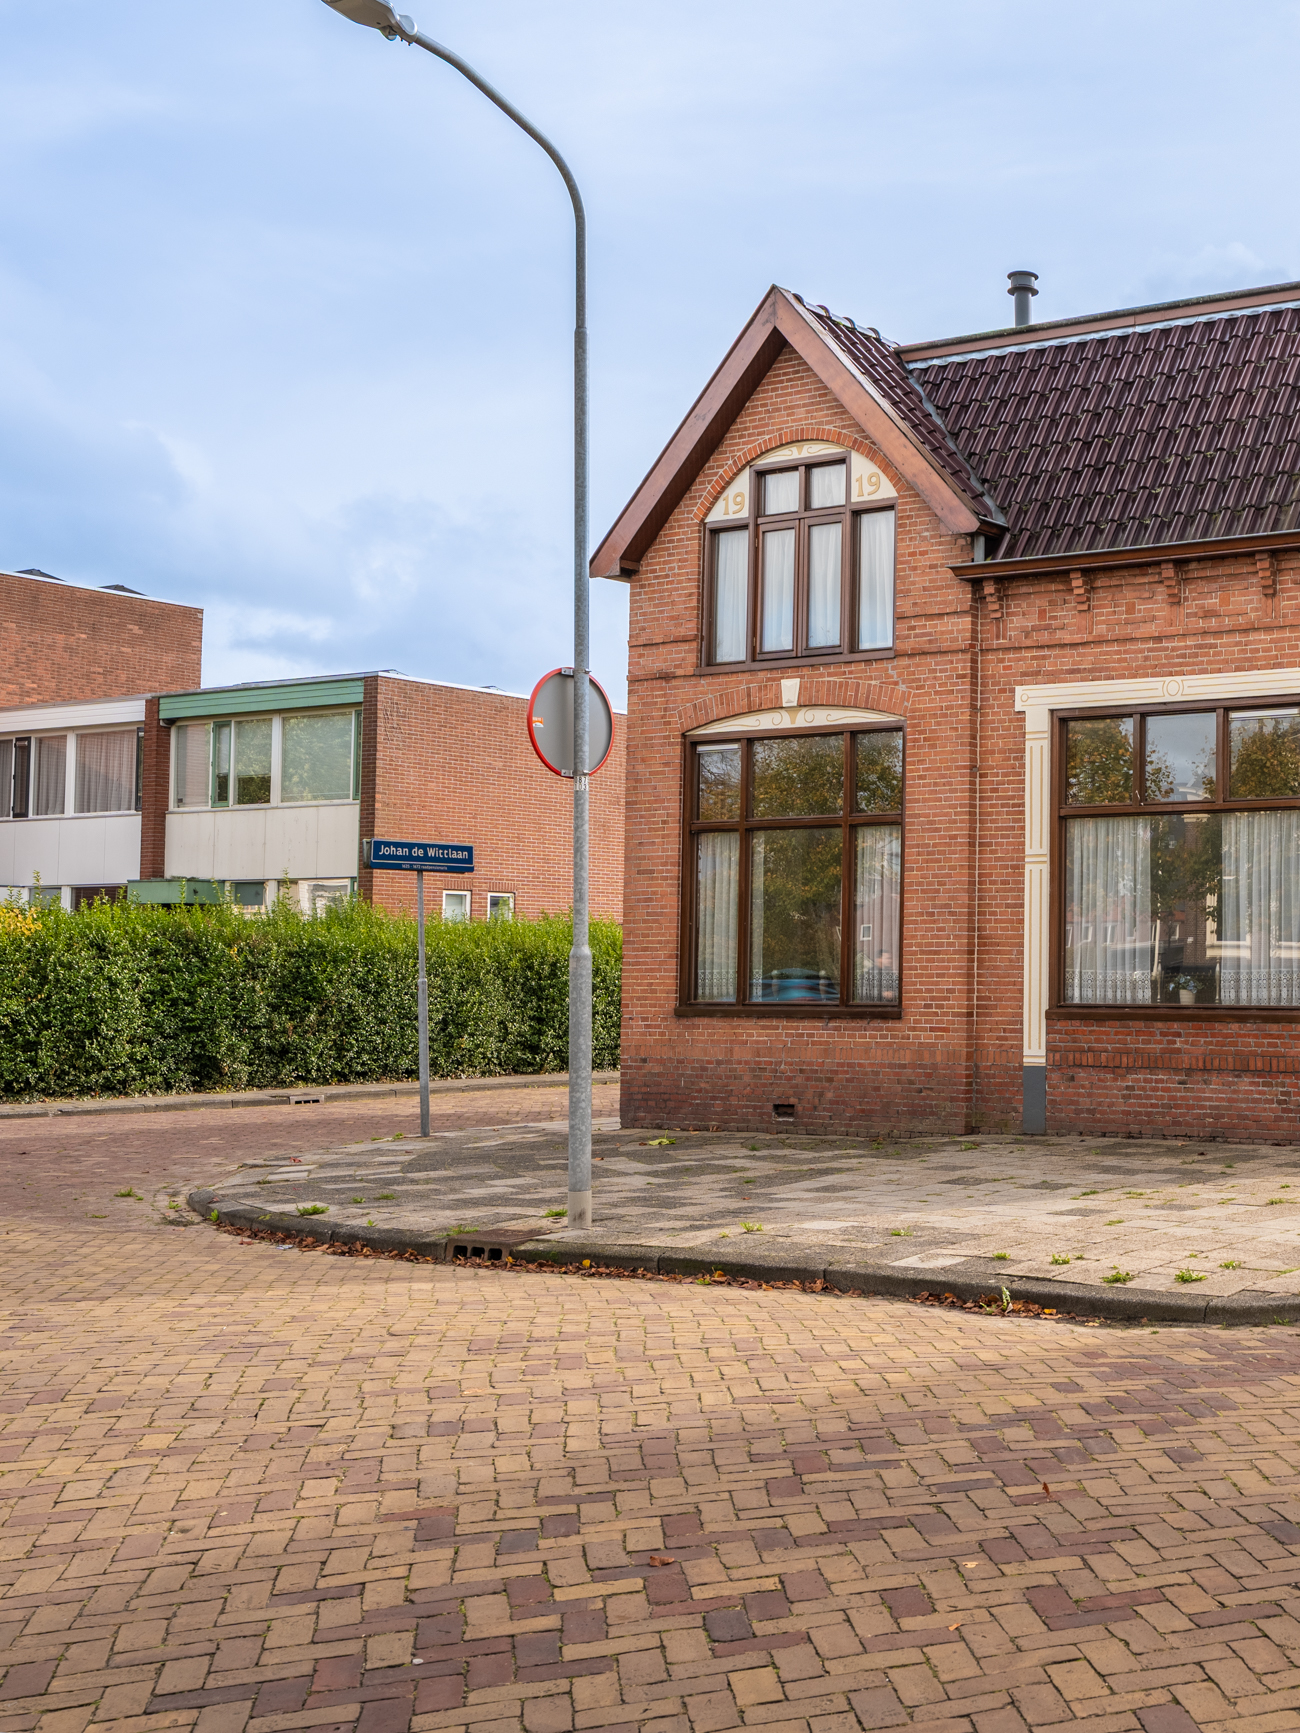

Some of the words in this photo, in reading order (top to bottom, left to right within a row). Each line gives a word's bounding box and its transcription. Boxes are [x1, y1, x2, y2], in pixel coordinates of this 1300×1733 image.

[722, 491, 746, 516] 19
[855, 471, 881, 498] 19
[379, 845, 409, 856] Johan
[411, 846, 424, 857] de
[427, 847, 469, 859] Wittlaan
